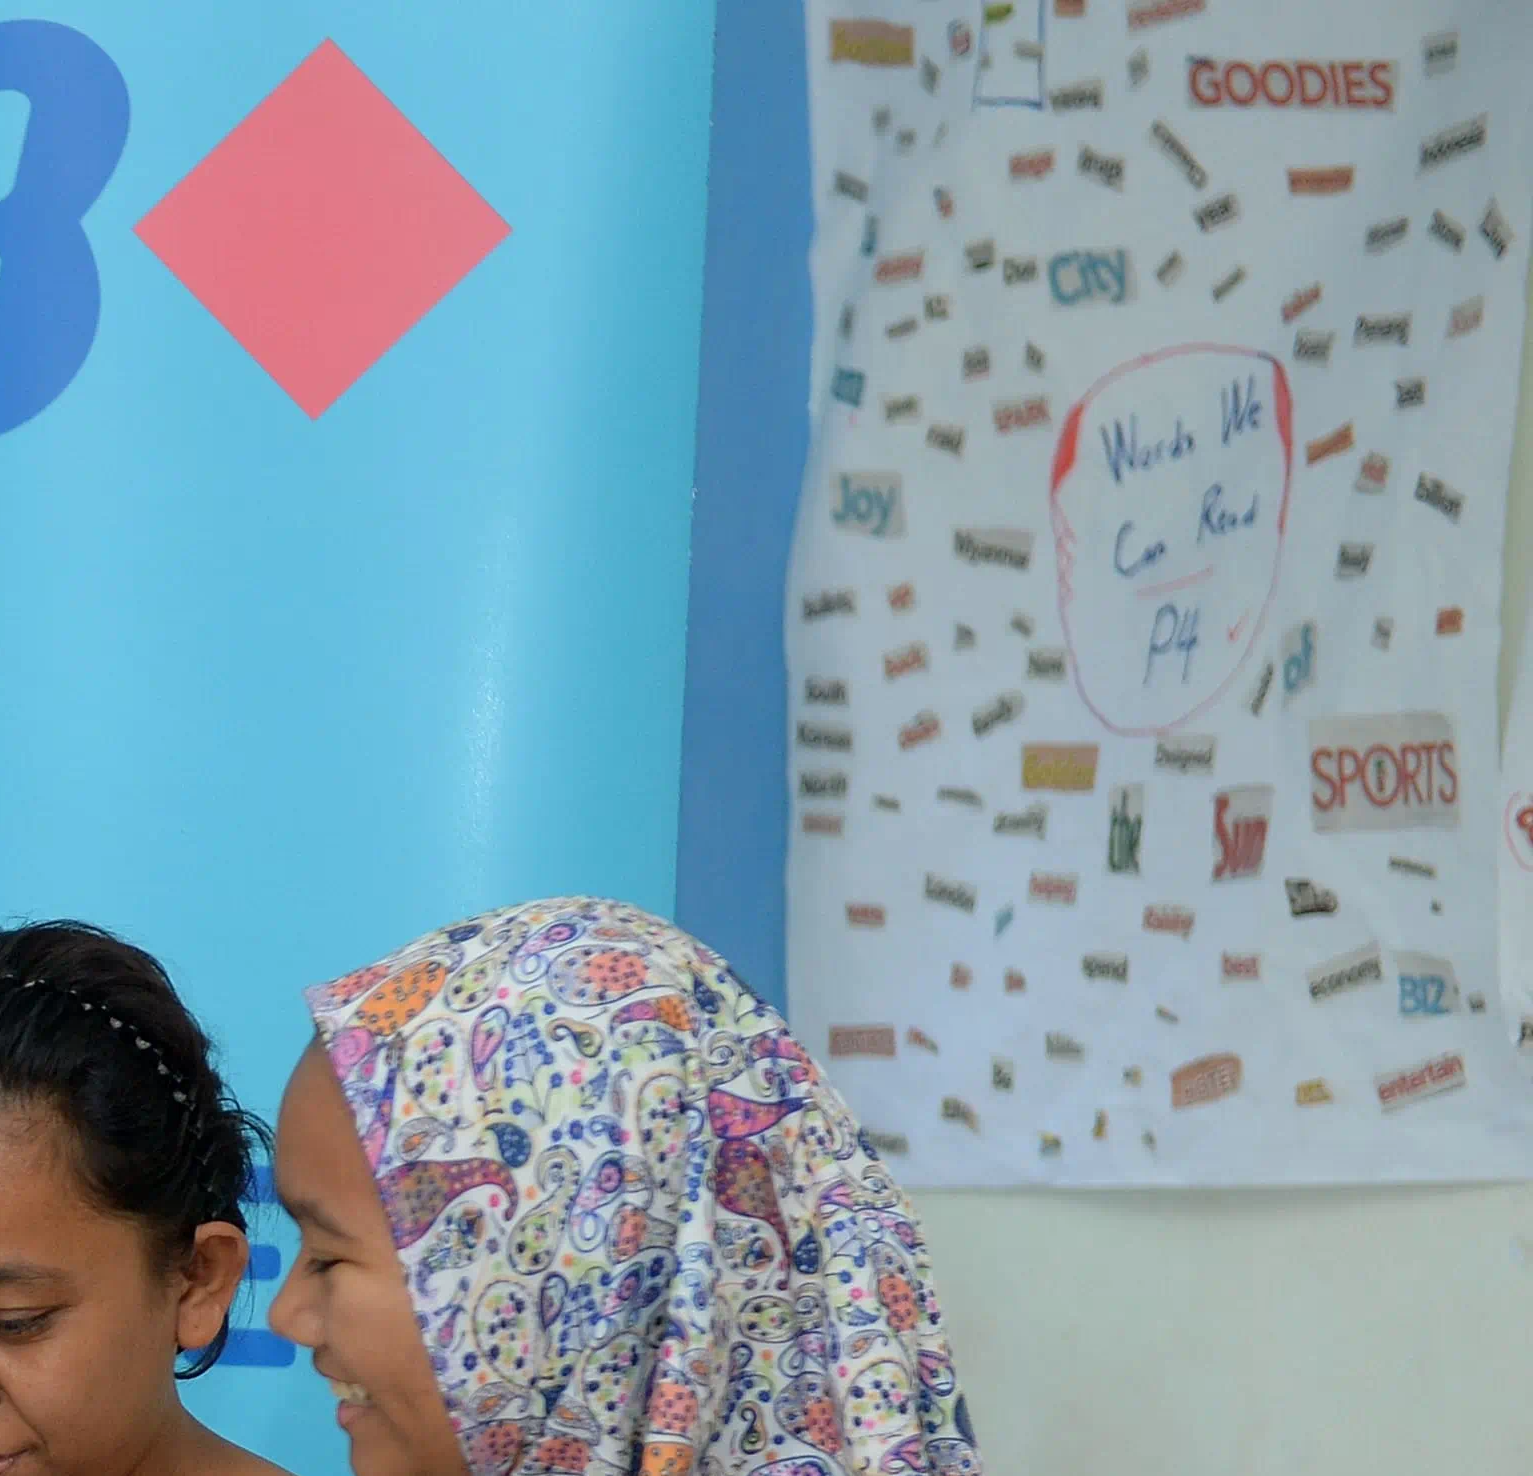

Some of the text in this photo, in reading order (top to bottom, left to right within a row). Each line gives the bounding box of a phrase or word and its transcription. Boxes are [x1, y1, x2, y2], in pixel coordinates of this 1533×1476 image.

[1188, 59, 1395, 109] GOODIES
[1048, 250, 1127, 305] City
[1099, 411, 1196, 485] Words
[1219, 373, 1263, 447] We
[830, 472, 897, 537] Joy
[1113, 481, 1260, 578] Can Read
[1141, 601, 1200, 686] P4
[1309, 740, 1459, 812] SPORTS
[1212, 791, 1269, 880] Sun
[1377, 1053, 1465, 1102] entertain
